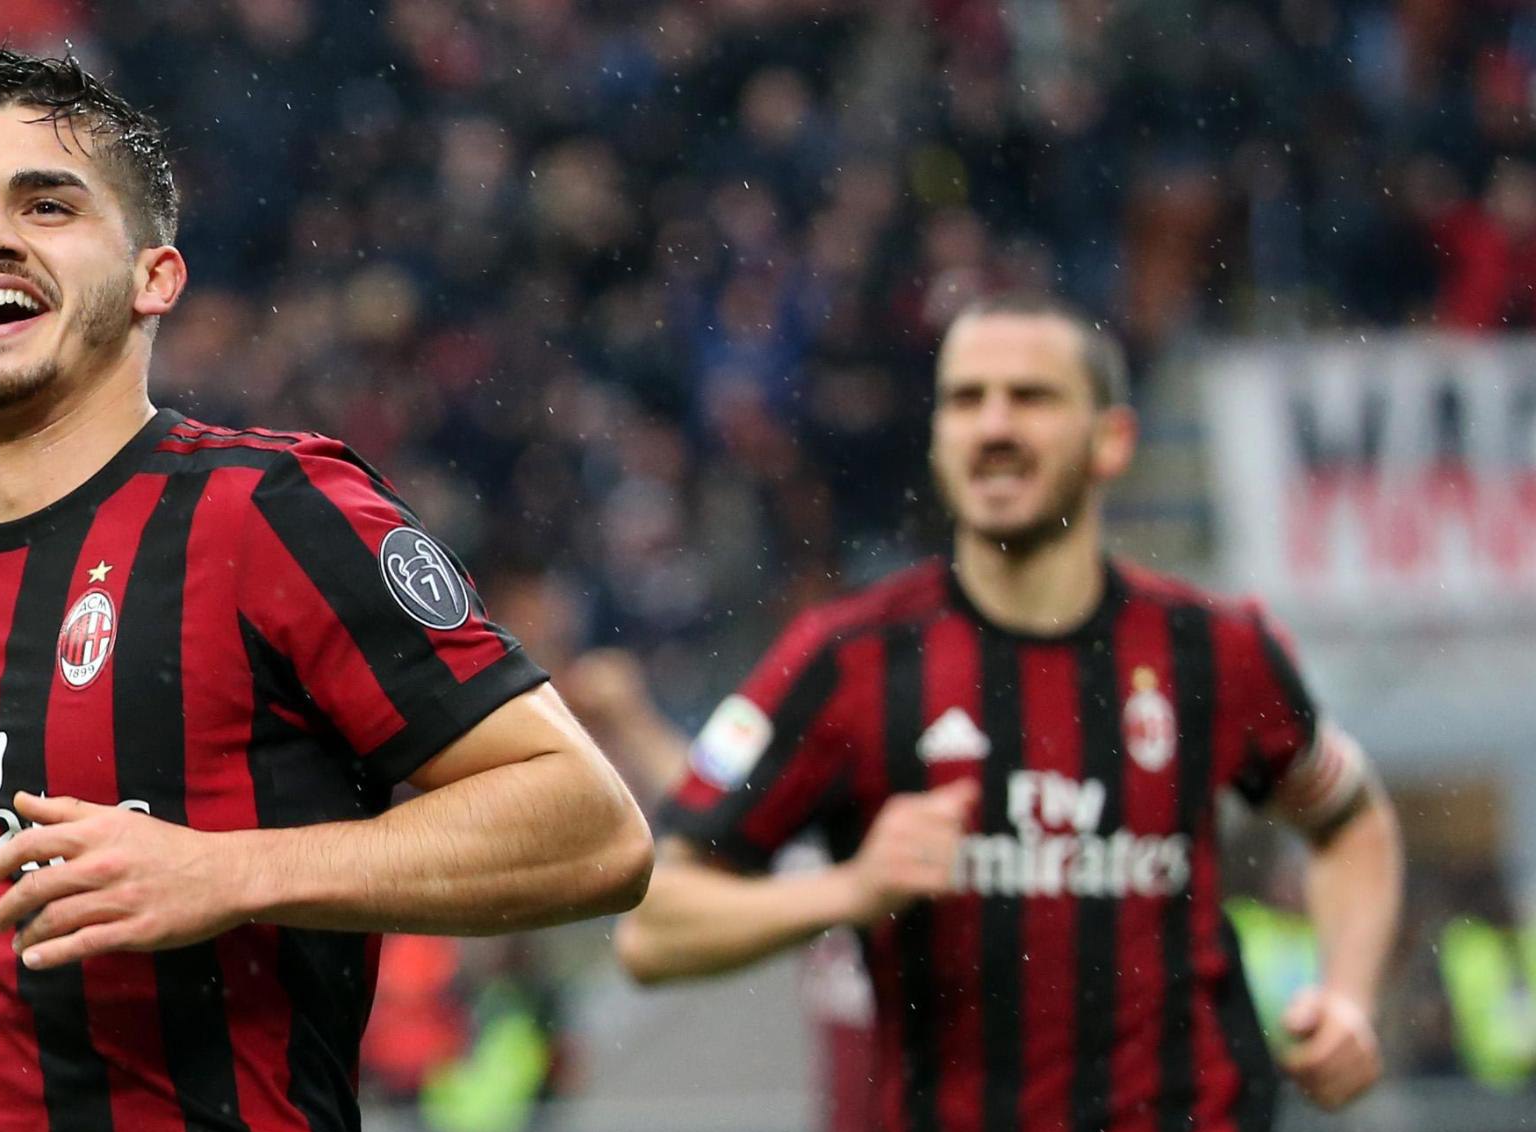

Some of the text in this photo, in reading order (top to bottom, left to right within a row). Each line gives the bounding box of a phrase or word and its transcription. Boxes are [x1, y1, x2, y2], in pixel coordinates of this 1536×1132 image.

[420, 573, 441, 602] 7
[79, 596, 107, 612] ACM
[68, 664, 95, 678] 1899
